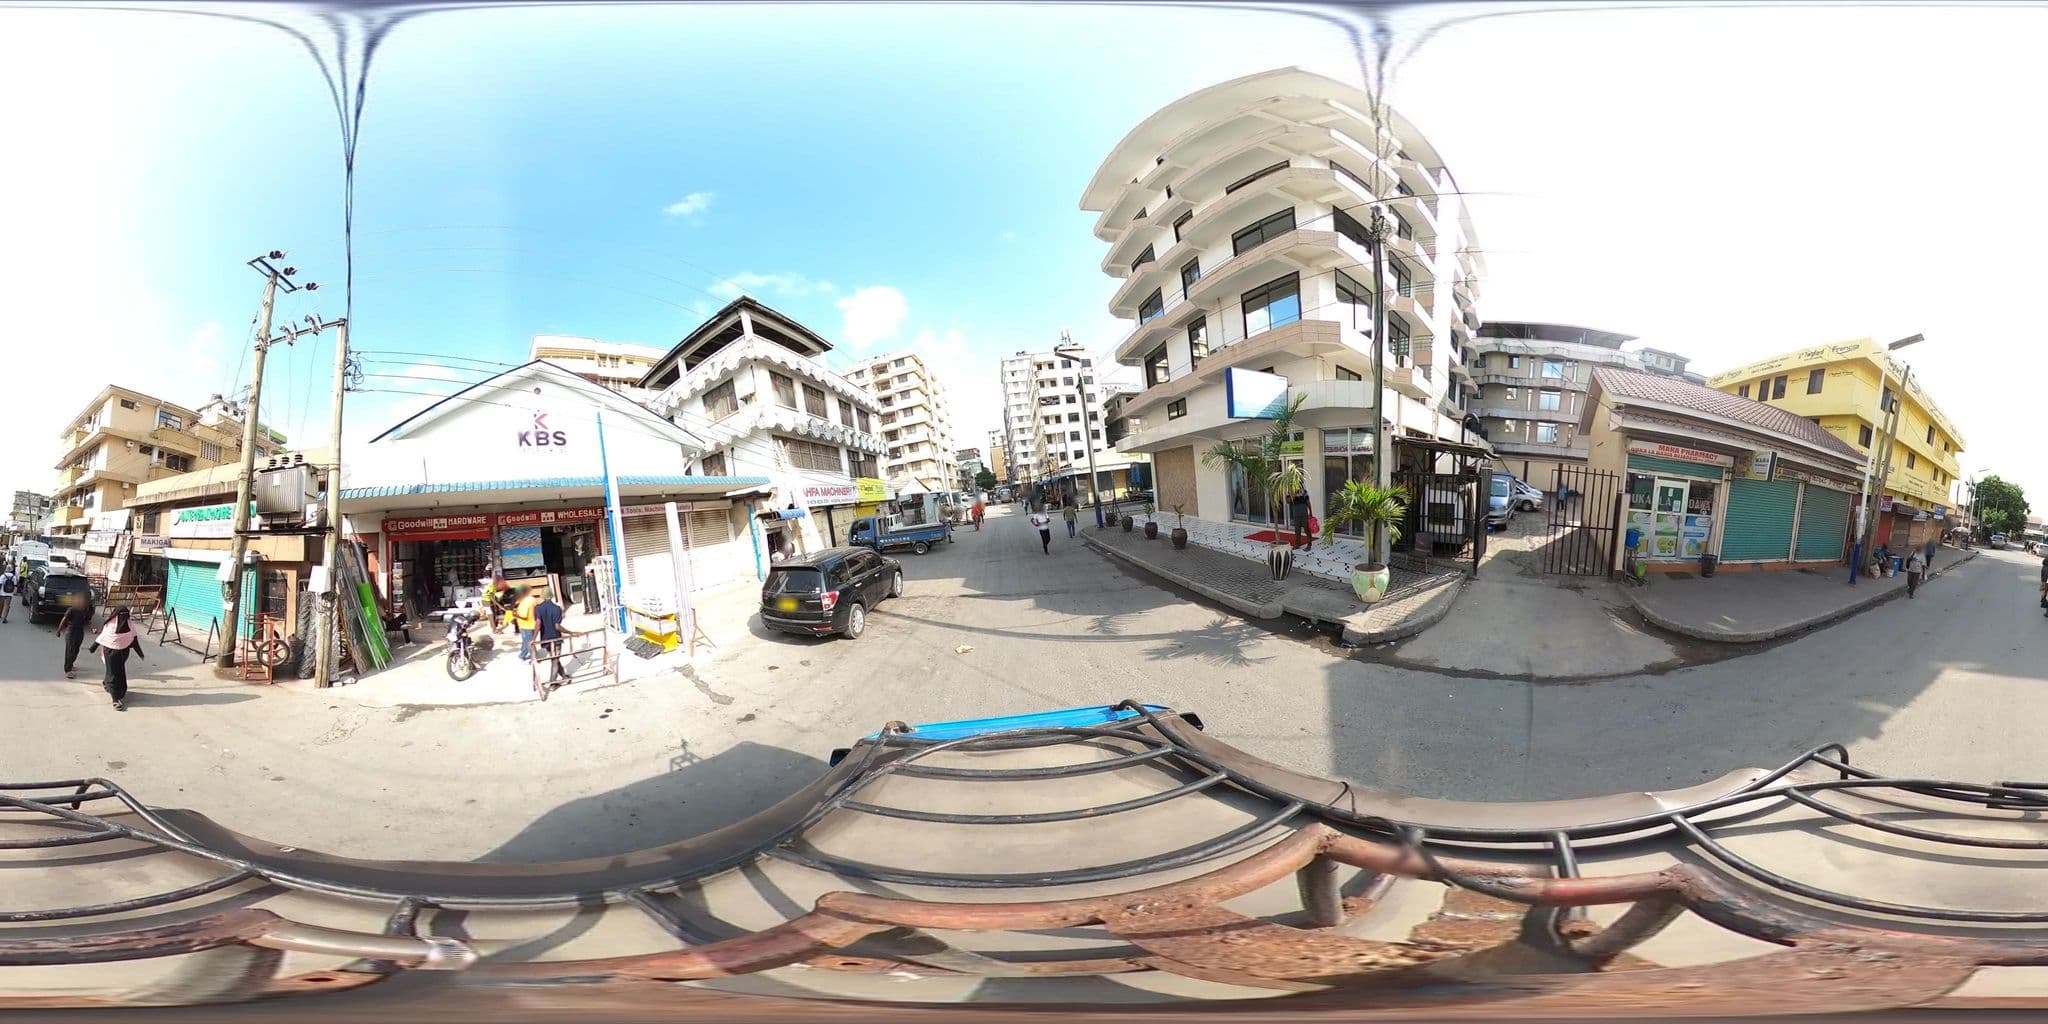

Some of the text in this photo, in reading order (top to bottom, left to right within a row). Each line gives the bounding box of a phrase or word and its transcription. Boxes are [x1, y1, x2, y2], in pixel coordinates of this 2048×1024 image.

[518, 431, 567, 447] KBS
[1680, 448, 1718, 461] PHARMACY
[397, 519, 433, 530] Goodwill
[448, 516, 487, 526] HARDWARE
[506, 513, 537, 524] Goodwill
[557, 508, 602, 519] WHOLESALE
